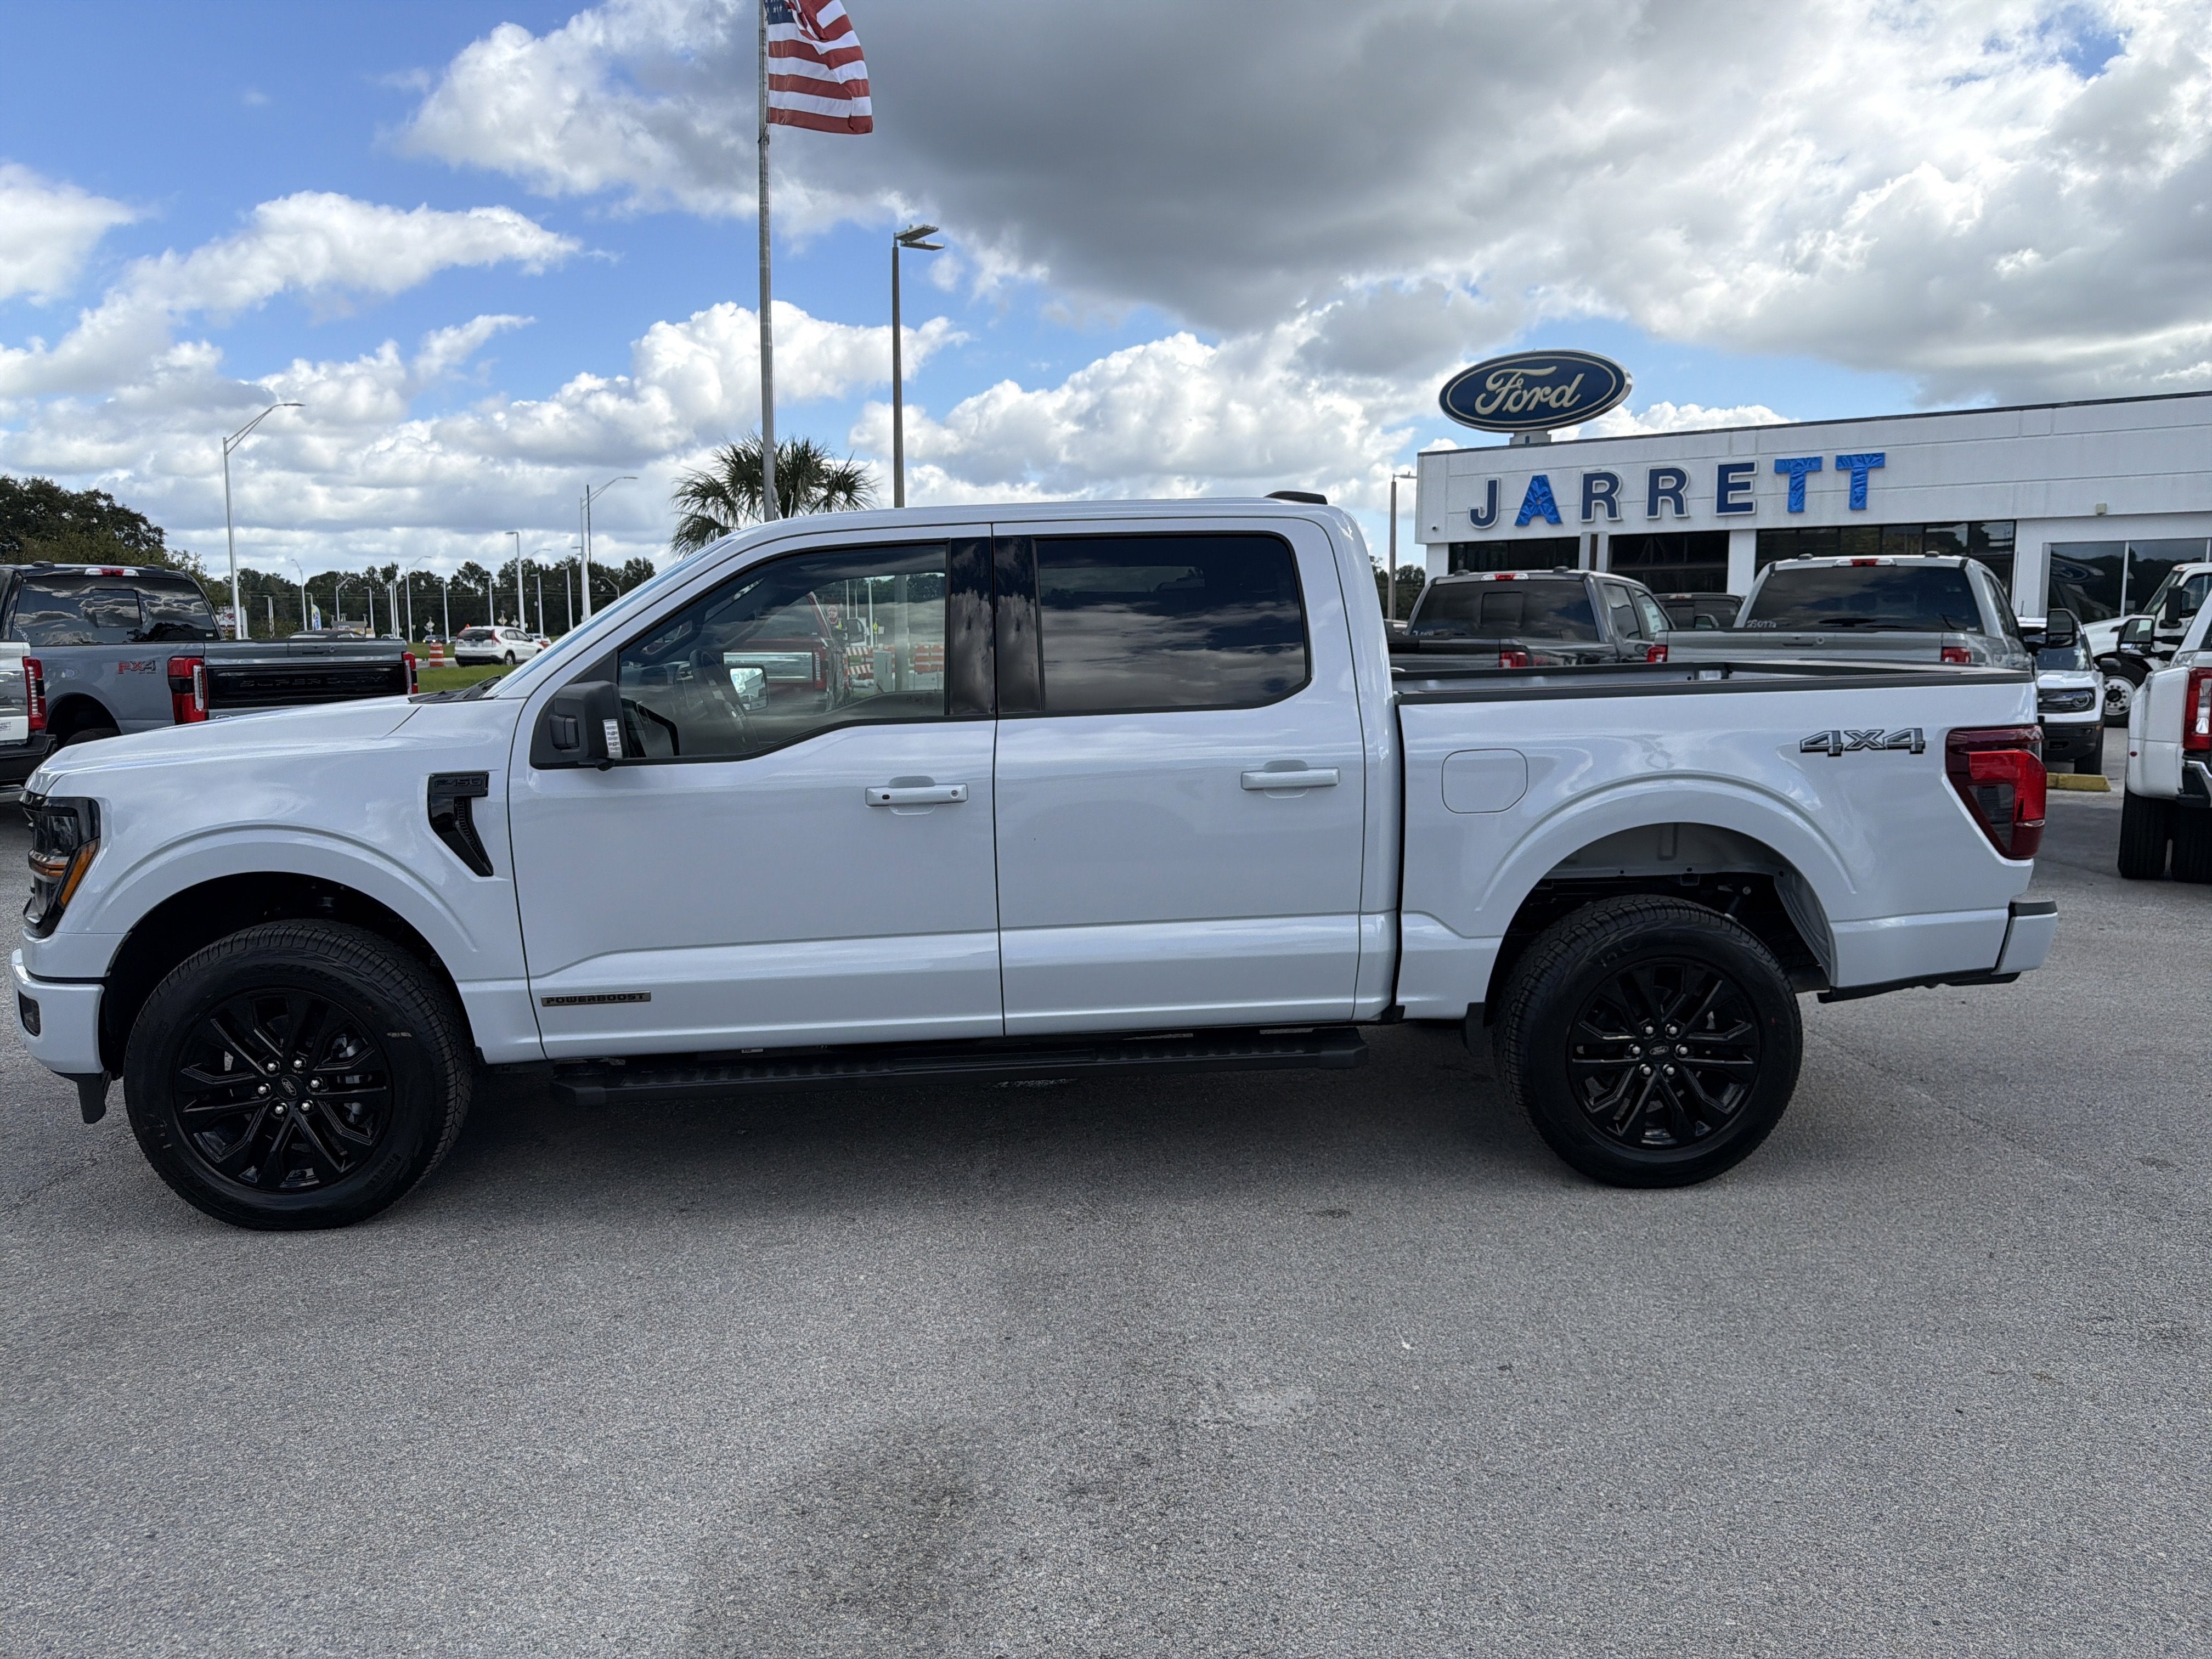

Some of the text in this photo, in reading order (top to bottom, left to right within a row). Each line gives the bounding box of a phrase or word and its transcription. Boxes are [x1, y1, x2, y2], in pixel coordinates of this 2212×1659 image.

[1475, 366, 1584, 415] Ford
[1468, 452, 1886, 529] JARRETT
[119, 661, 156, 674] FX4
[546, 993, 645, 1004] POWERBOOST
